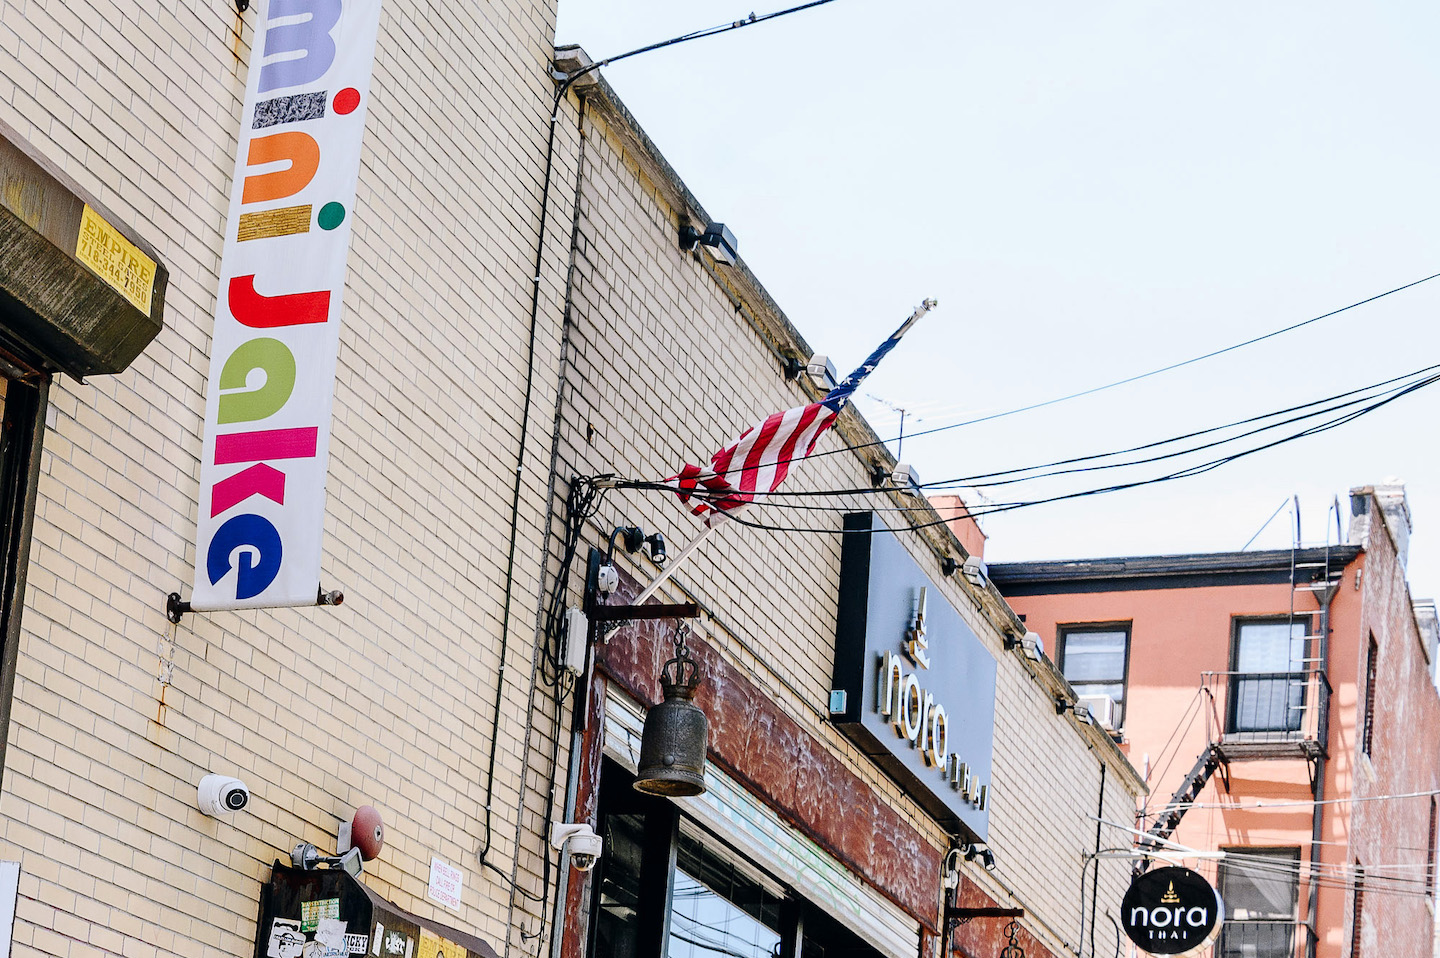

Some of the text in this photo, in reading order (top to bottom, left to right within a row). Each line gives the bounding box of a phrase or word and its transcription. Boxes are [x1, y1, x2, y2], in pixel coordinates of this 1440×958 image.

[81, 231, 148, 292] STEEL GATES
[81, 239, 148, 304] 718-344-7950
[83, 216, 151, 284] EMPIRE
[206, 0, 361, 600] mini Jake
[881, 649, 989, 812] nora THAI
[1130, 906, 1207, 928] nora
[1148, 930, 1188, 940] THAI
